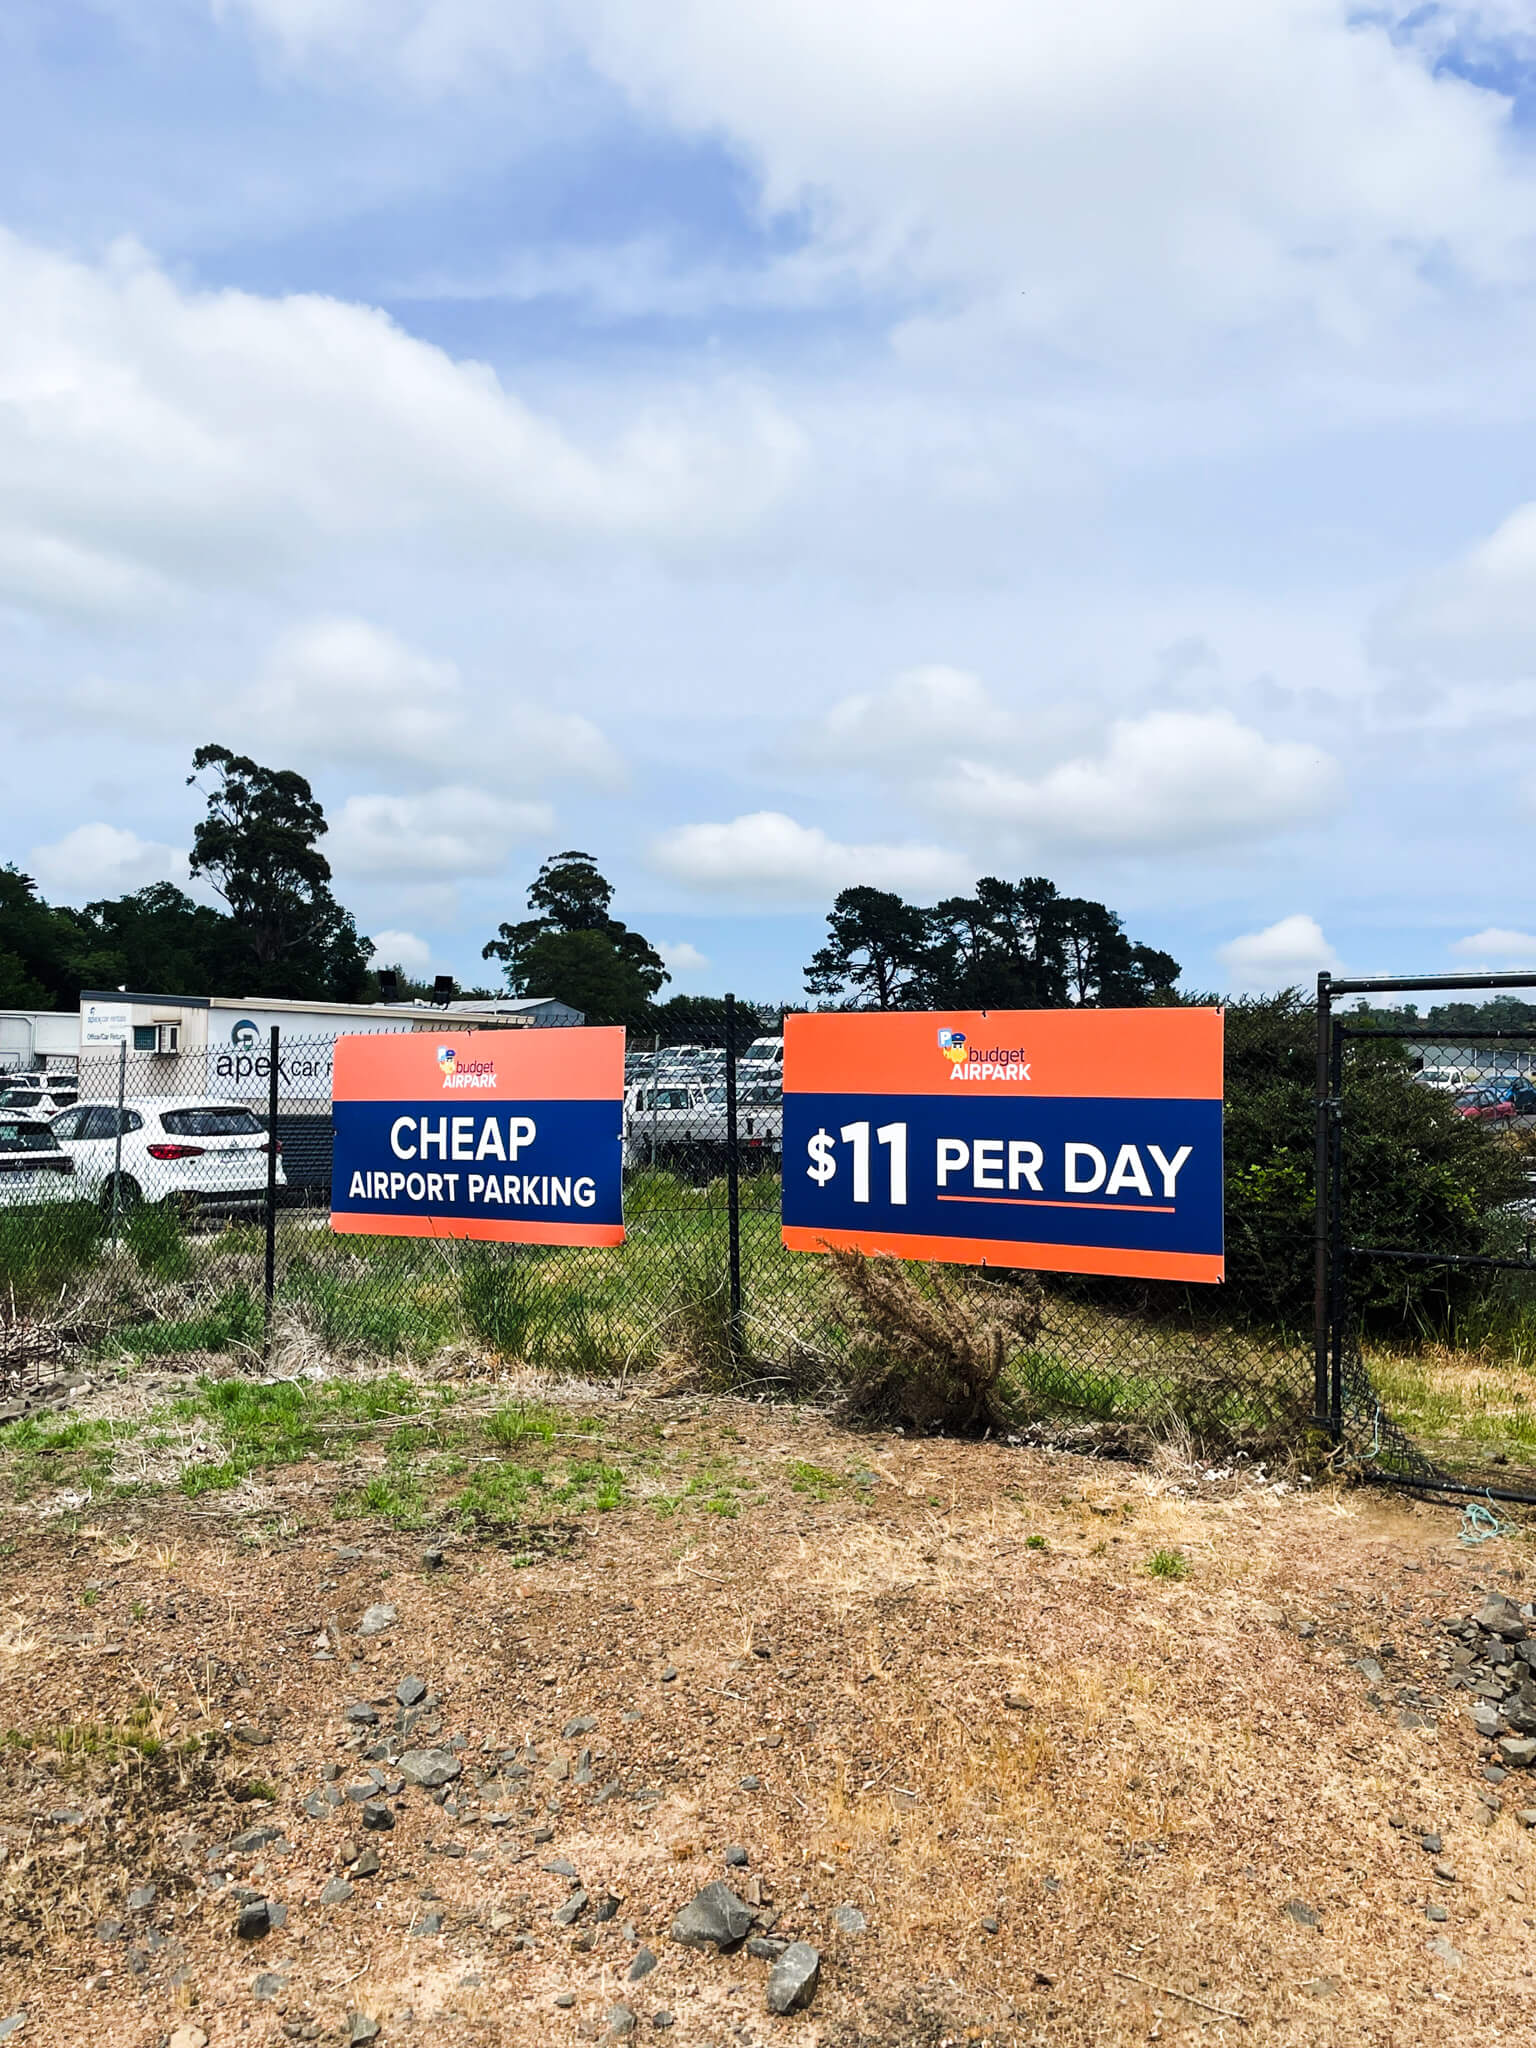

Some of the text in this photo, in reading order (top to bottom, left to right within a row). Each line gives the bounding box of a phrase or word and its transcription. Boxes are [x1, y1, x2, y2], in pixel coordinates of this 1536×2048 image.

[969, 1047, 1025, 1066] budget
[291, 1061, 320, 1076] car
[456, 1060, 493, 1076] budget
[950, 1063, 1031, 1080] AIRPARK
[442, 1074, 497, 1088] AIRPARK
[390, 1116, 537, 1161] CHEAP
[806, 1121, 1193, 1205] $11 PER DAY
[349, 1171, 596, 1208] AIRPORT PARKING
